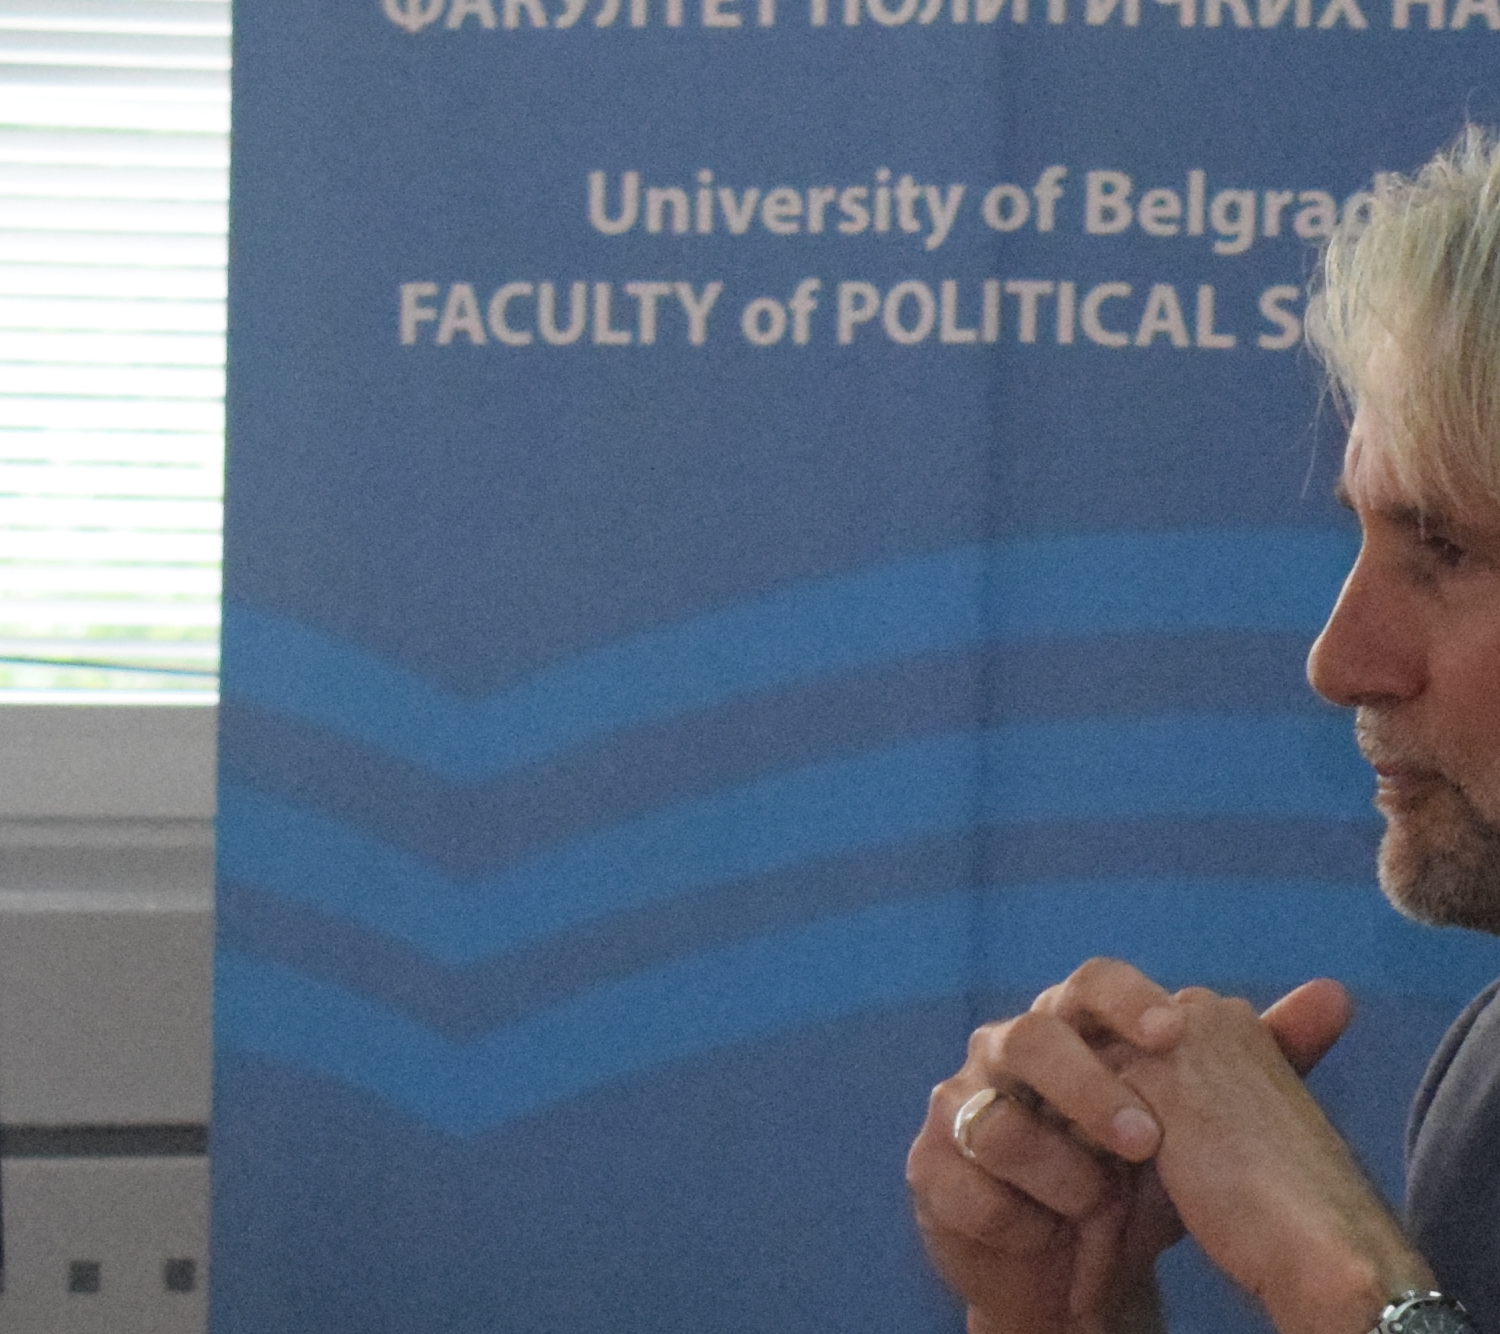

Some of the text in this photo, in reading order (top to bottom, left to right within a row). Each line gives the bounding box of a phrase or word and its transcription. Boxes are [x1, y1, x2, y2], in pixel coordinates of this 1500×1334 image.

[587, 167, 966, 251] University
[980, 164, 1068, 233] of
[399, 280, 723, 347] FACULTY
[740, 277, 821, 347] of
[836, 278, 1237, 350] POLITICAL
